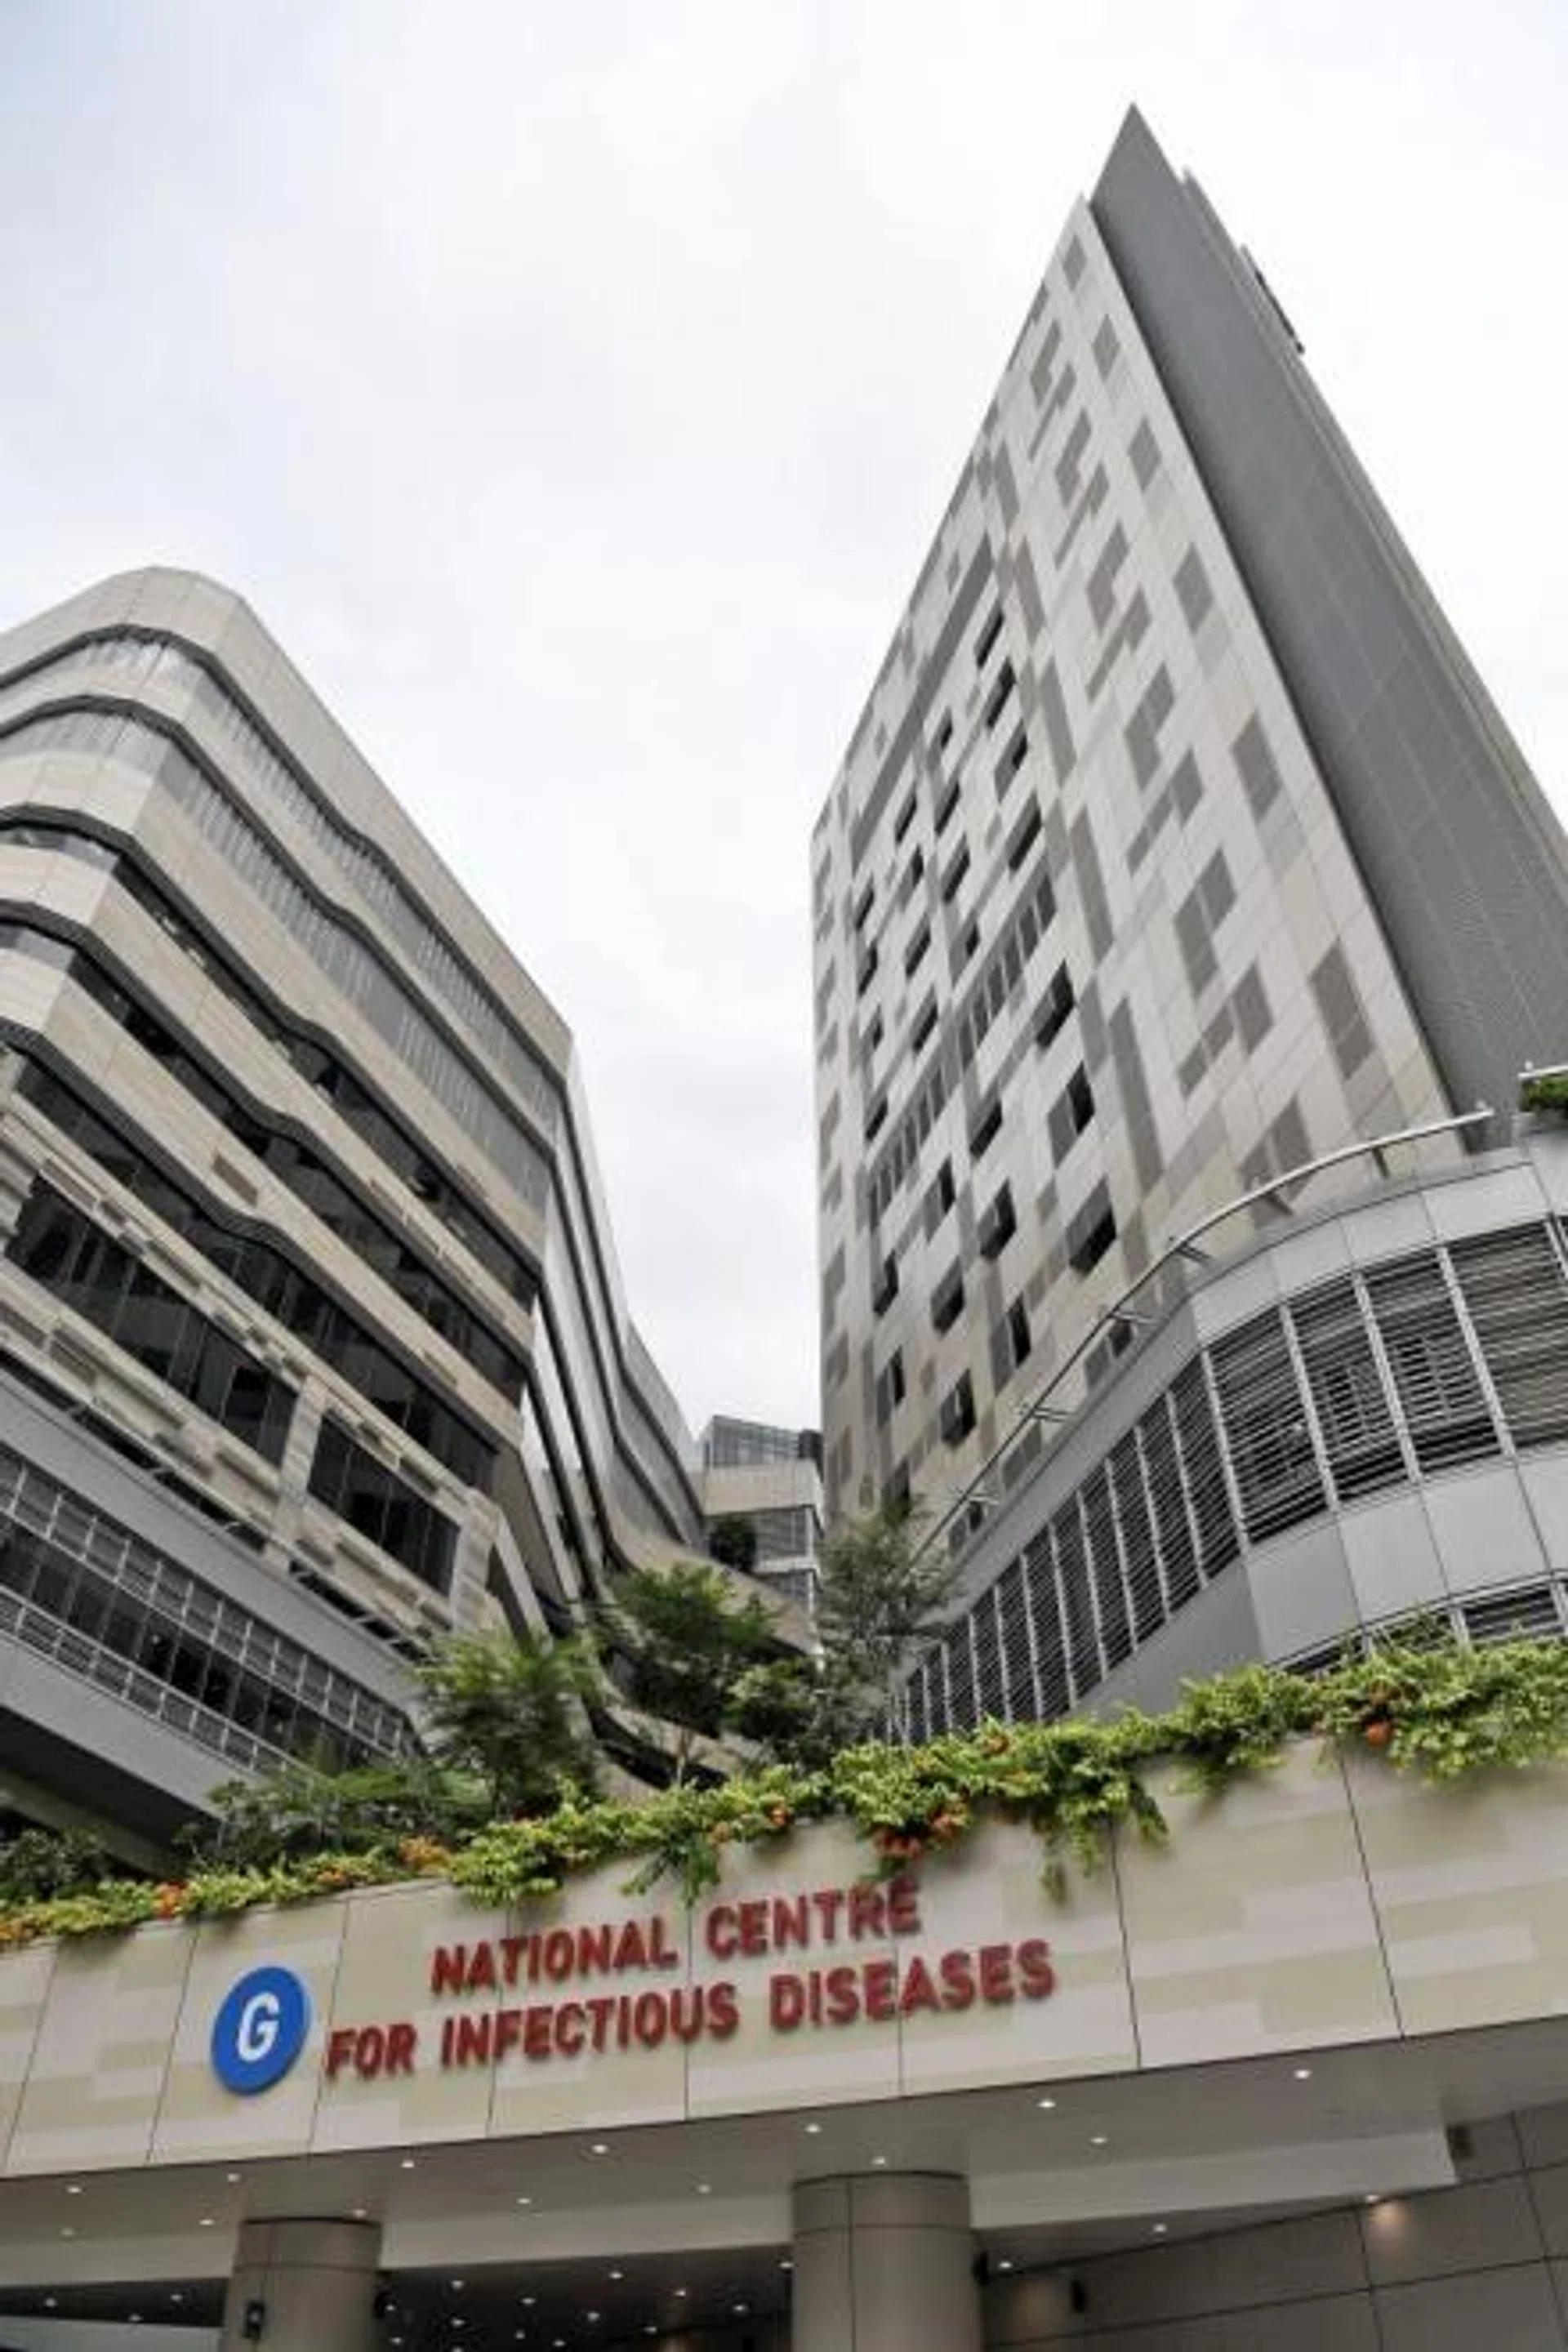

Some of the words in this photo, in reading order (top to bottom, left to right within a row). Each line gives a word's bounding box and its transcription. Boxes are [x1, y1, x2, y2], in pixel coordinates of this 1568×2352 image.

[432, 1913, 678, 1993] NATIONAL
[706, 1876, 920, 1958] CENTRE
[237, 1993, 281, 2061] G
[327, 2022, 416, 2076] FOR
[442, 1984, 739, 2066] INFECTIOUS
[770, 1940, 1056, 2029] DISEASES
